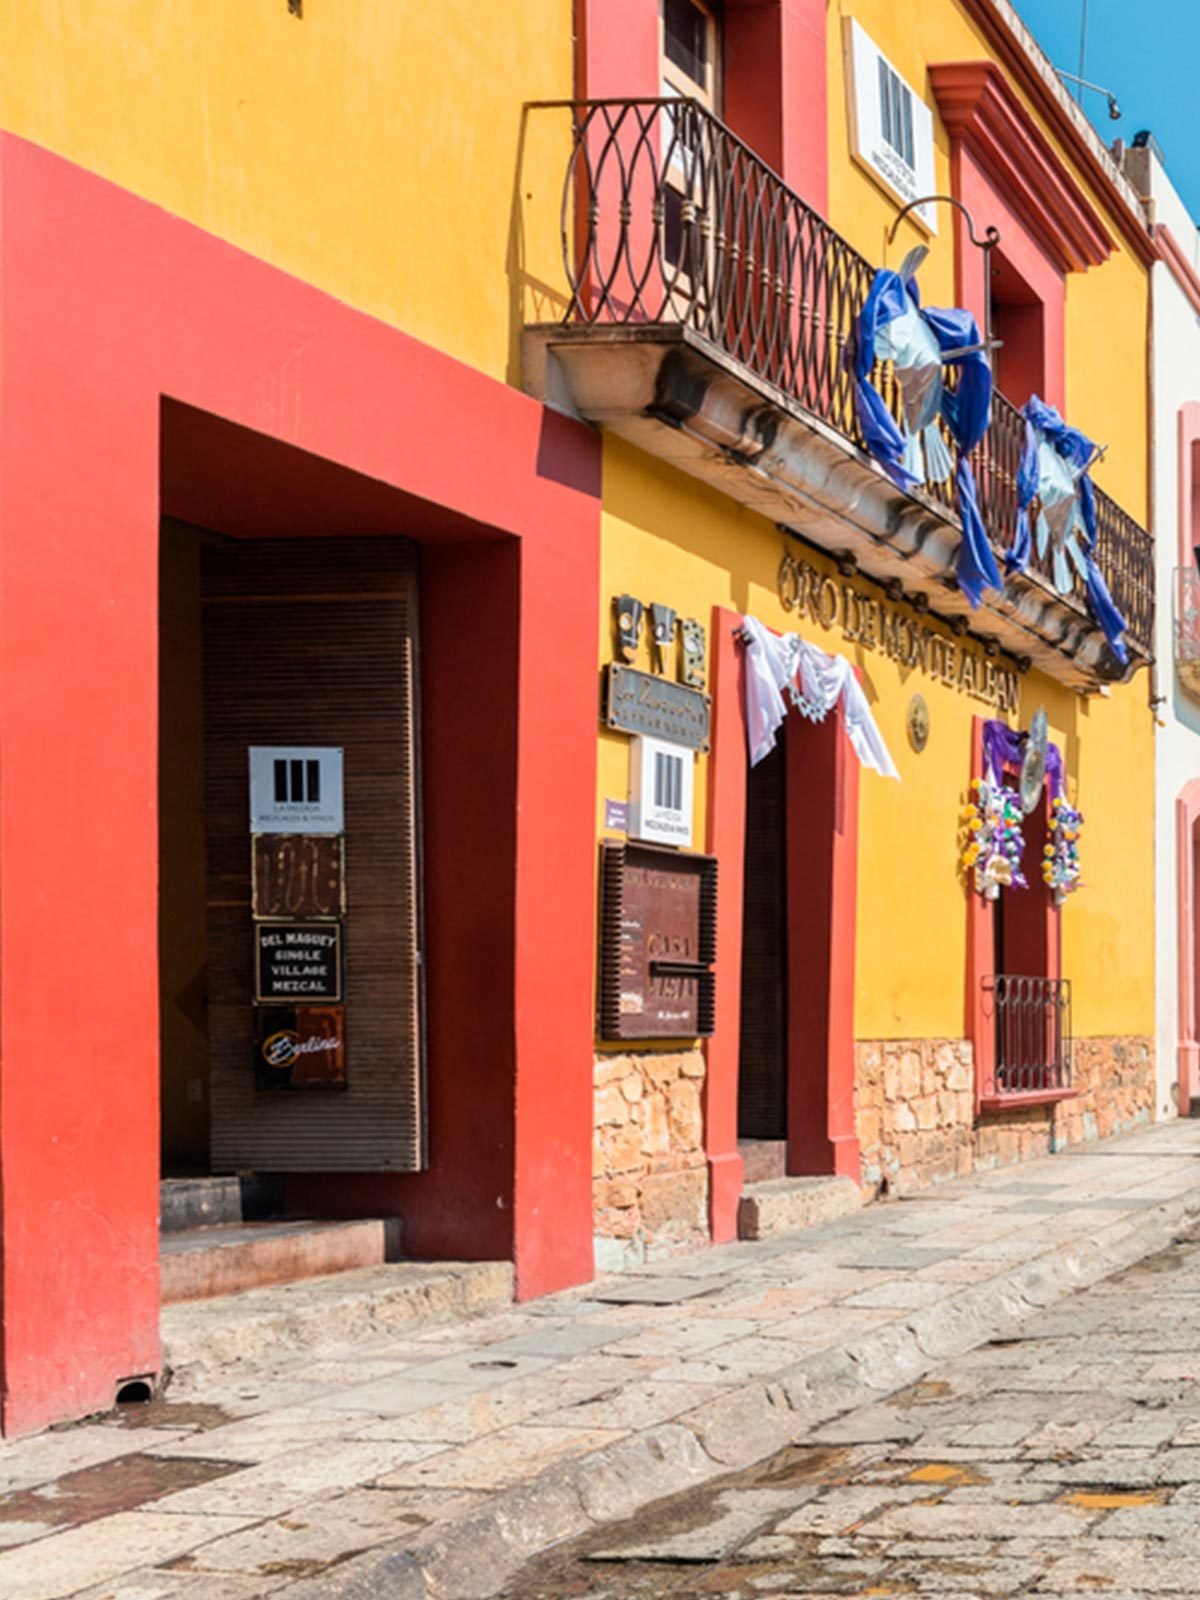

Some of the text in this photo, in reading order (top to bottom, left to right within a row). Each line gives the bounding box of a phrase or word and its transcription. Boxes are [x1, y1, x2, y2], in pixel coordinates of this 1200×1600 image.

[778, 556, 839, 631] ORO
[842, 586, 877, 651] DE
[879, 604, 956, 689] MONTE
[261, 933, 336, 948] DEL MAGUEY
[648, 933, 690, 958] CASA
[275, 950, 321, 961] SINGLE
[271, 965, 328, 976] VILLAGE
[272, 981, 327, 992] MEZCAL
